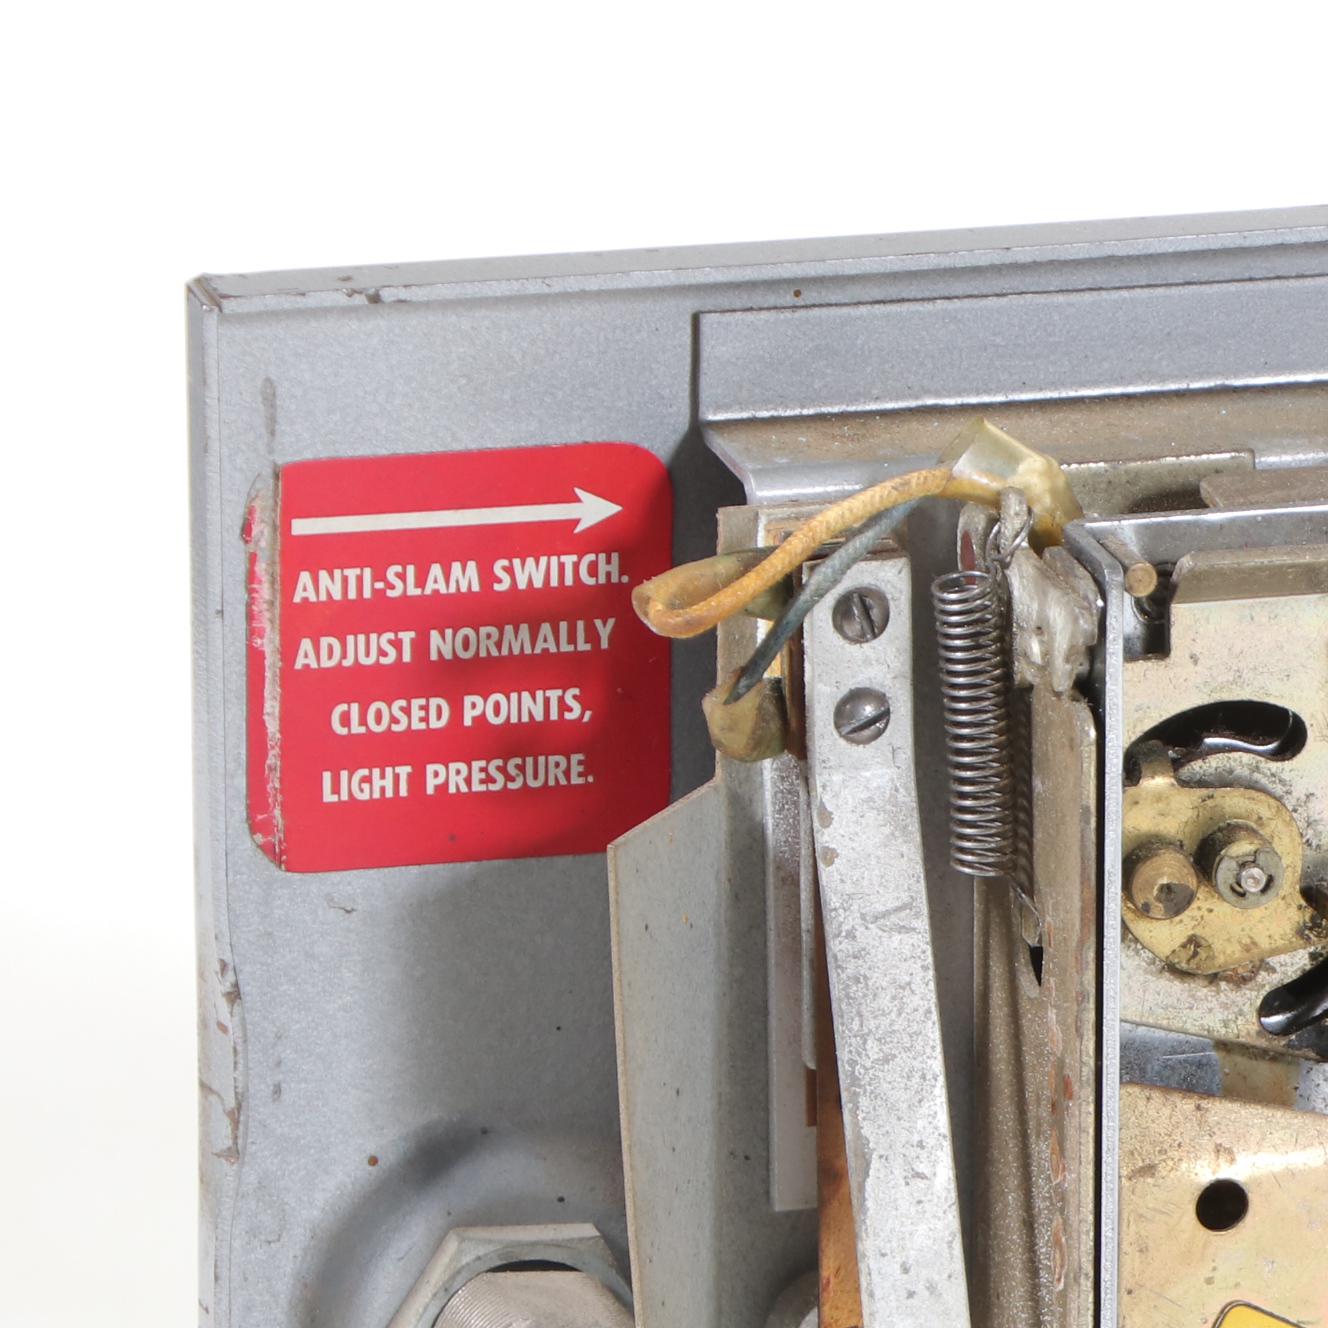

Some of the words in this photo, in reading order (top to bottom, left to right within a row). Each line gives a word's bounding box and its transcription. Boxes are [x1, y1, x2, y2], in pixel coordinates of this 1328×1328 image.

[293, 561, 480, 603] ANTI-SLAM
[493, 552, 629, 591] SWITCH.
[294, 632, 415, 669] ADJUST
[429, 618, 616, 661] NORMALLY
[331, 698, 449, 735] CLOSED
[463, 688, 592, 726] POINTS,
[322, 765, 412, 803] LIGHT
[425, 753, 594, 795] PRESSURE.
